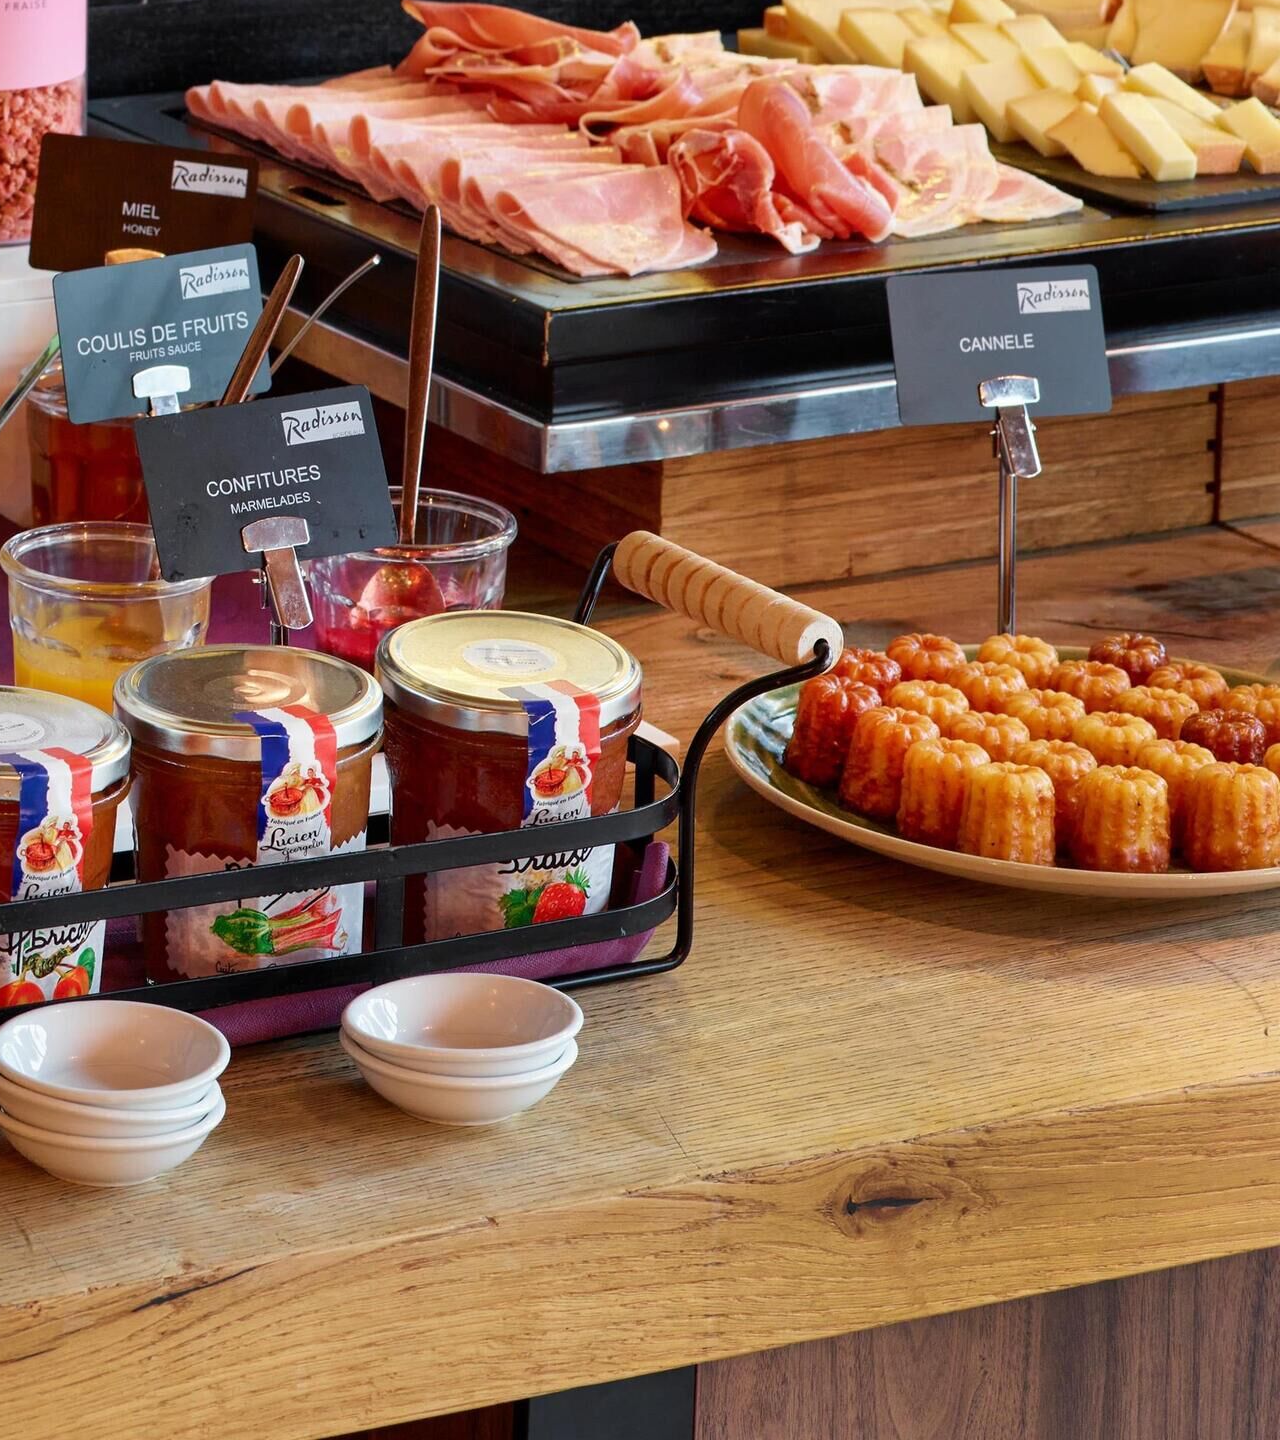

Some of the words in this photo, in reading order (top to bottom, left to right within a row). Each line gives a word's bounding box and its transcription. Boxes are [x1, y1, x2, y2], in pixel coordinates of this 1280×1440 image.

[4, 0, 48, 11] FRAISE
[172, 163, 248, 192] Radisson
[121, 201, 161, 220] MIEL
[122, 223, 161, 236] HONEY
[180, 263, 249, 299] Radisson
[1018, 282, 1089, 312] Radisson
[76, 328, 147, 356] COULIS
[151, 322, 178, 342] DE
[182, 311, 249, 339] FRUITS
[959, 333, 1035, 353] CANNELE
[129, 345, 167, 362] FRUITS
[167, 340, 202, 356] SAUCE
[282, 408, 363, 445] Radisson
[206, 464, 321, 497] CONFITURES
[230, 491, 311, 514] MARMELADES
[260, 820, 323, 851] Lucien
